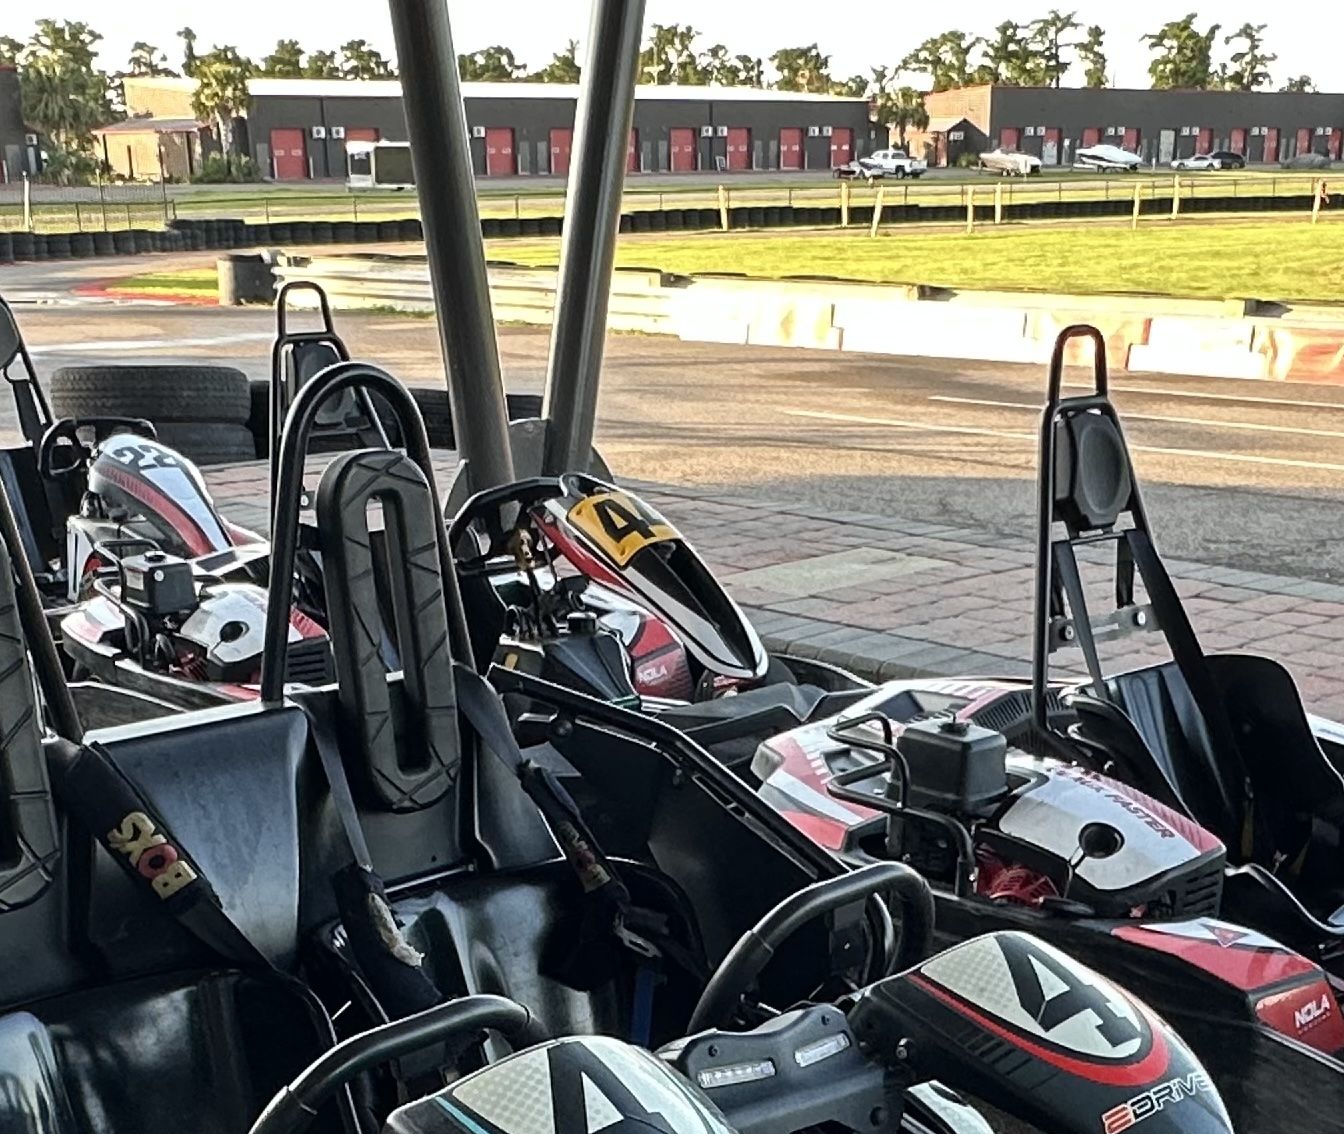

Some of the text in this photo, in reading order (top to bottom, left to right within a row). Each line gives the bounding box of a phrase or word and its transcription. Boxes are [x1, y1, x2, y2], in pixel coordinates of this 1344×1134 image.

[1104, 793, 1176, 839] FASTER
[994, 933, 1142, 1049] 4
[1294, 993, 1331, 1029] NOLA
